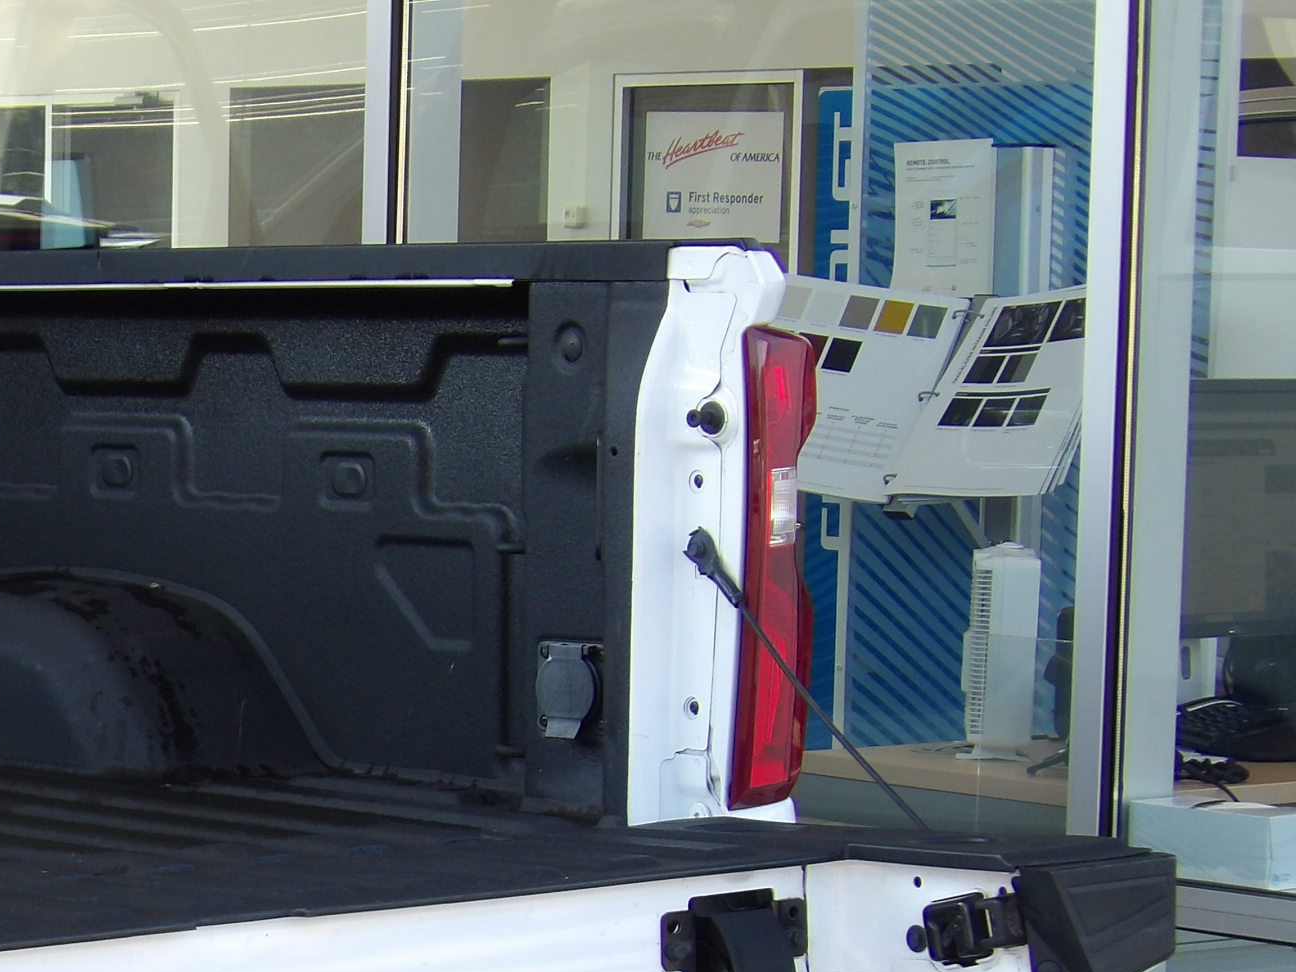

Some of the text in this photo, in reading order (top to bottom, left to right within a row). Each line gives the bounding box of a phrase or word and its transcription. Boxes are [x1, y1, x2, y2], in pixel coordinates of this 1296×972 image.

[647, 130, 780, 169] THE Heartbeat OF AMERICA
[688, 191, 764, 205] First Responder
[688, 206, 730, 215] appreciation
